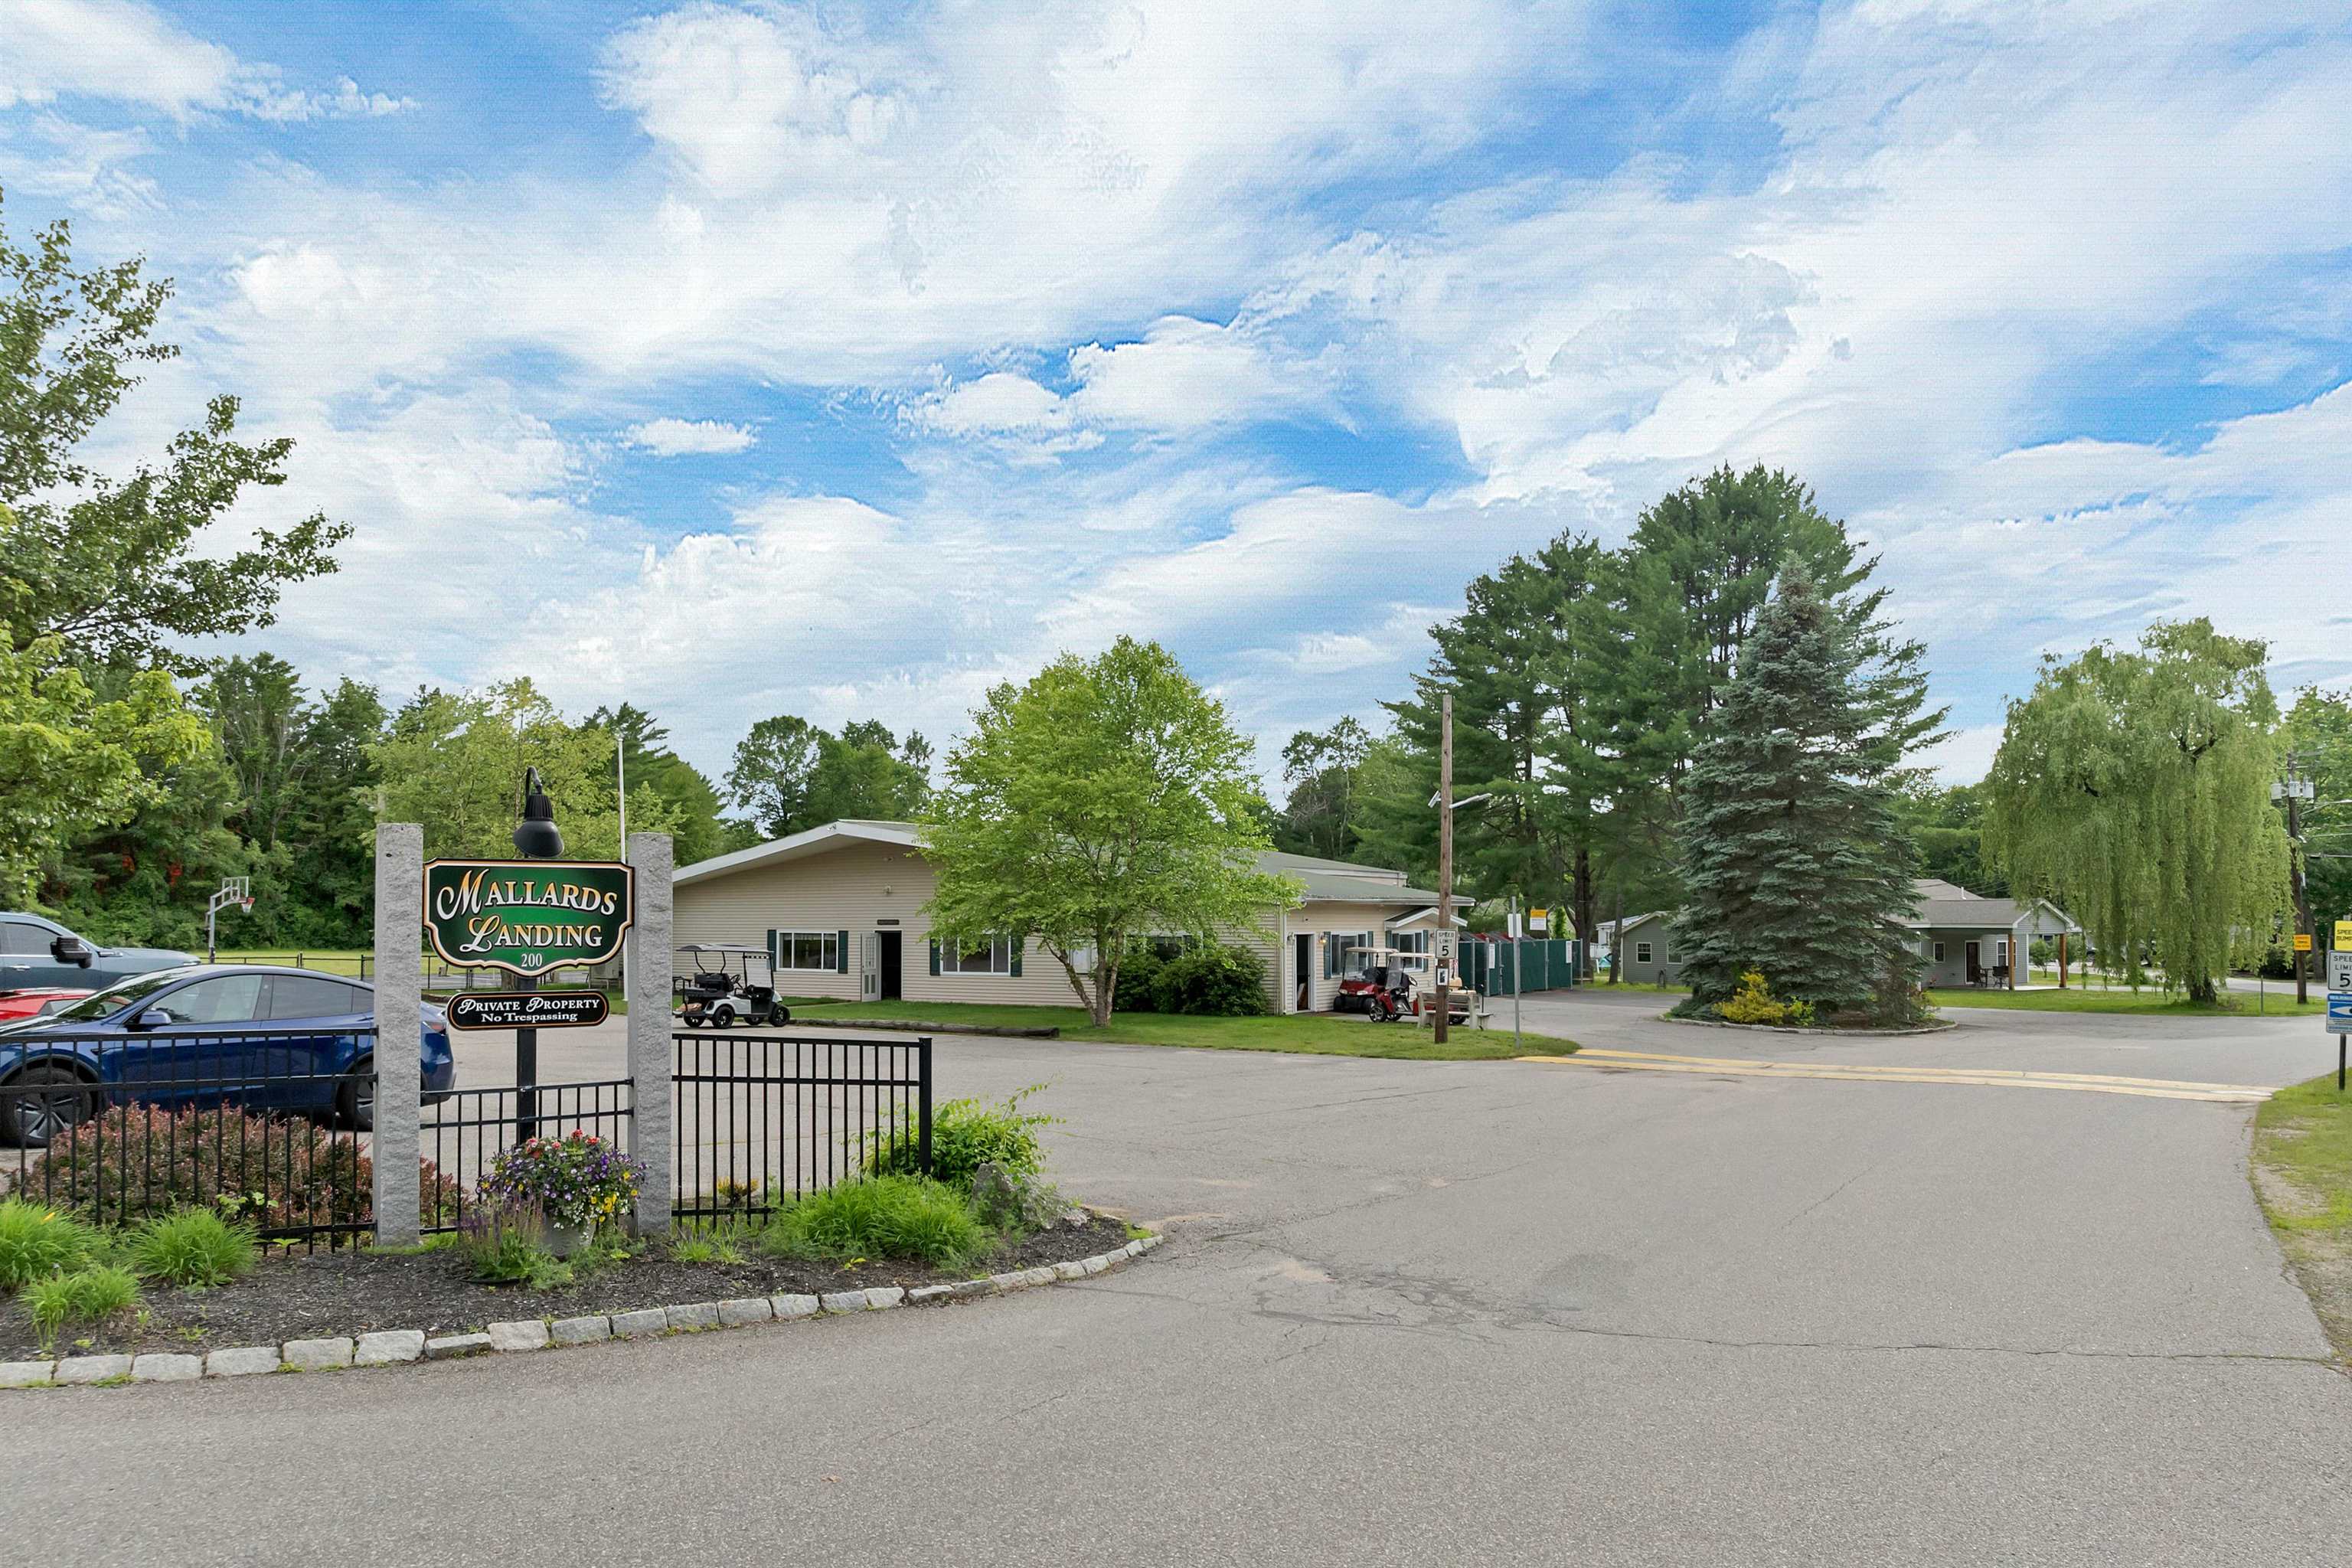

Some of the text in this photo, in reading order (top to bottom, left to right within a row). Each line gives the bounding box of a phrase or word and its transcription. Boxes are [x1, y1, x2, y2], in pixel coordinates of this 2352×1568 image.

[436, 868, 618, 920] MALLARDS
[459, 915, 603, 952] LANDING
[1442, 946, 1449, 956] 5
[521, 952, 543, 967] 200
[2340, 973, 2350, 988] 5
[458, 997, 600, 1014] PRIVATE PROPERTY
[481, 1012, 578, 1023] No Trespassing
